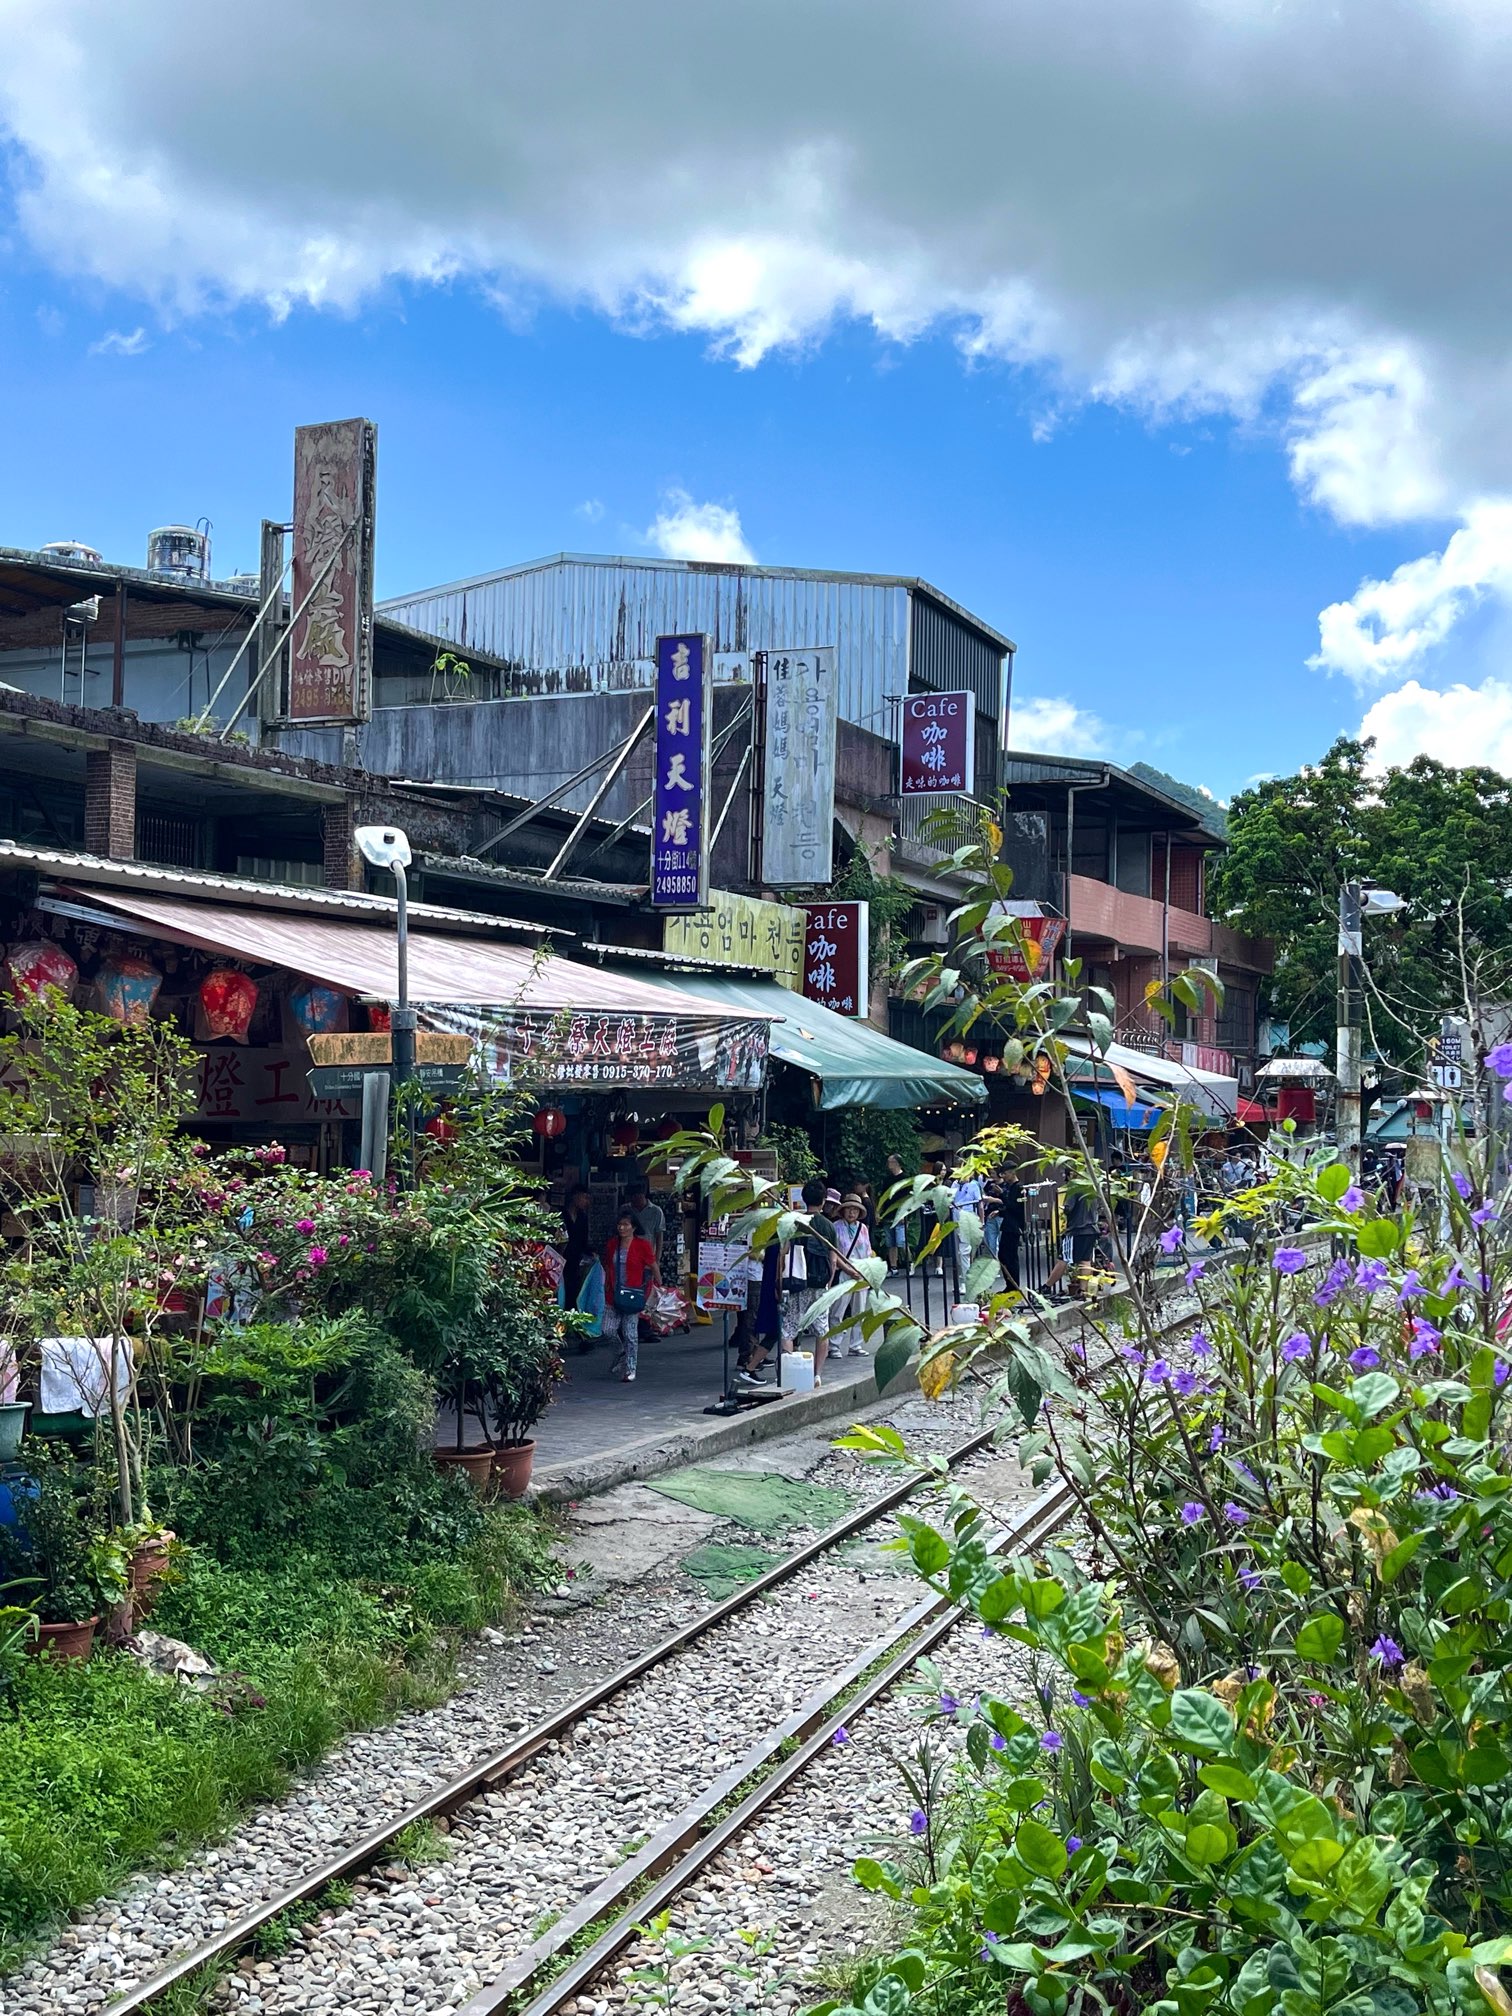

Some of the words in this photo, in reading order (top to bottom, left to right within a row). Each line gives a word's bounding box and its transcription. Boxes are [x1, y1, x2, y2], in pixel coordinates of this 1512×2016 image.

[911, 698, 958, 718] Cafe
[662, 642, 695, 845] 吉利天燈
[921, 721, 948, 772] 咖啡
[656, 876, 697, 894] 24958850
[807, 934, 838, 993] 咖啡
[602, 1065, 673, 1079] 0915-370-170
